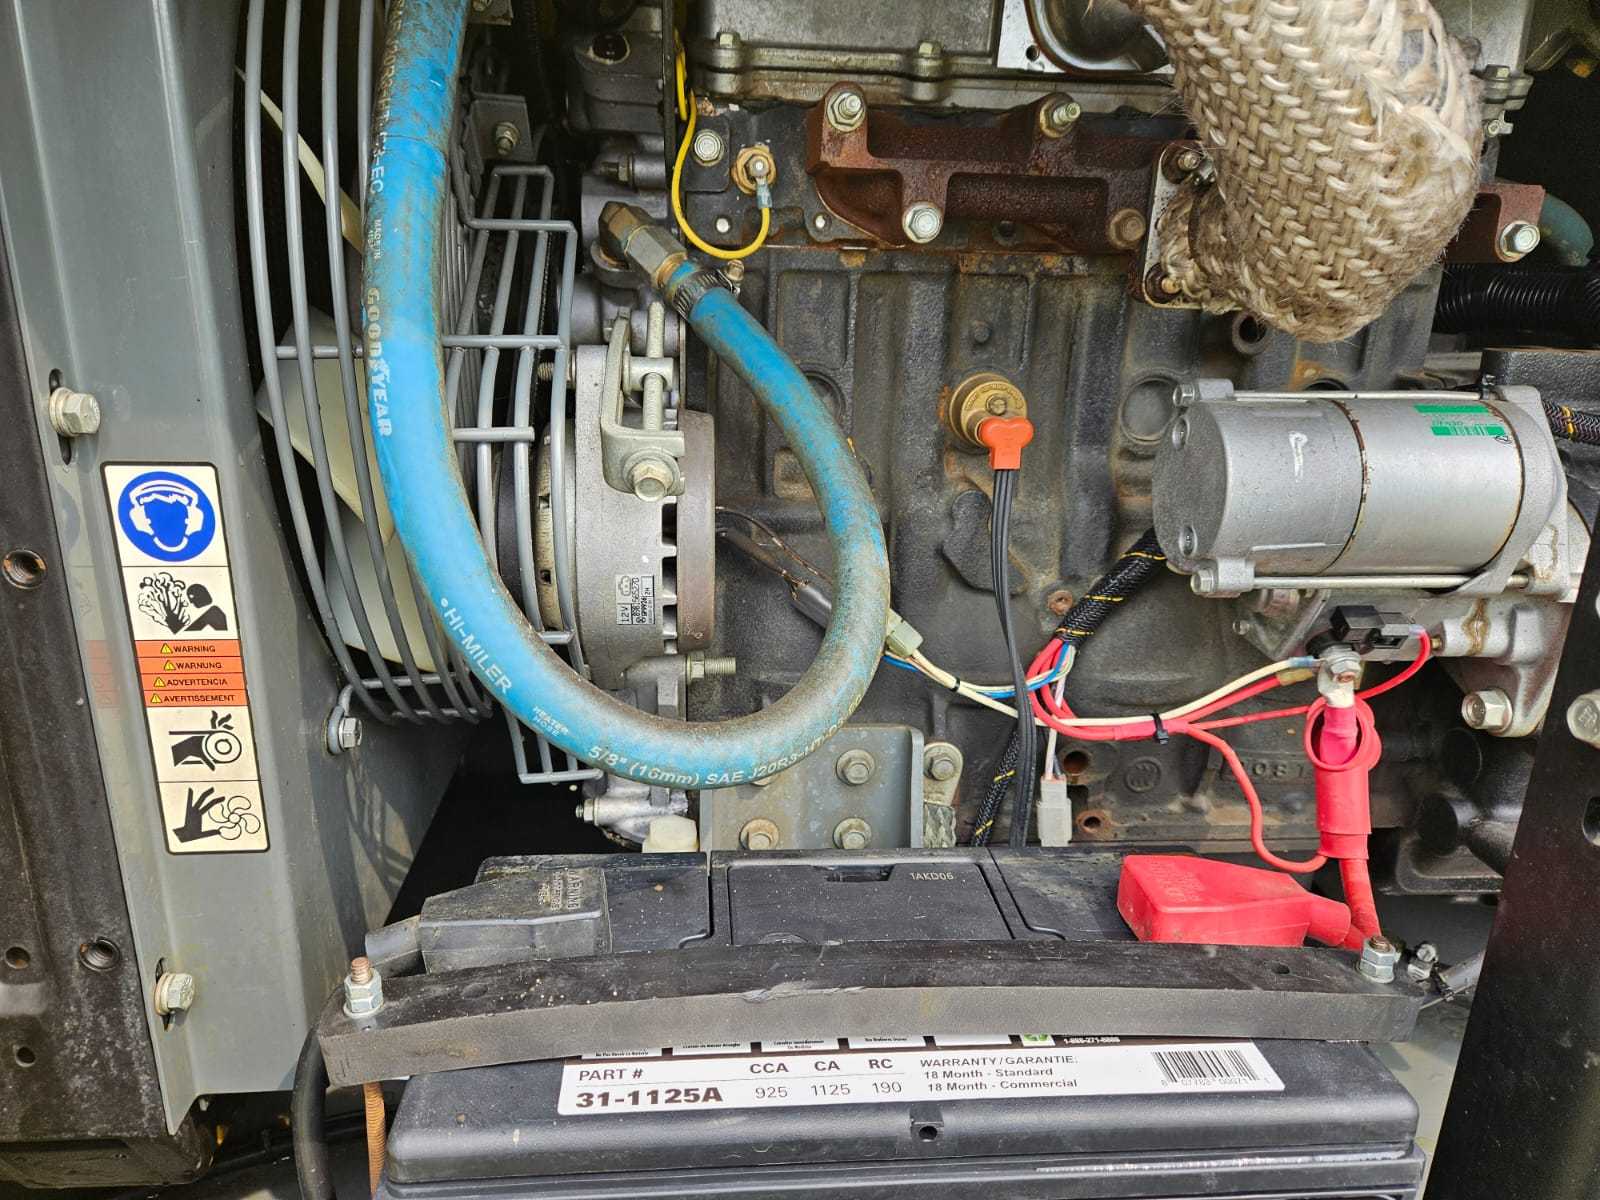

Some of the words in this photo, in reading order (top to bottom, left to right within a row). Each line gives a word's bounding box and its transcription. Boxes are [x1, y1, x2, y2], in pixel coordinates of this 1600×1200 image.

[367, 287, 392, 437] GOODYEAR
[173, 645, 216, 653] WARNING
[443, 607, 513, 694] HI-MILER
[176, 661, 222, 669] WARNUNG
[167, 678, 229, 687] ADVERTENCIA
[163, 694, 236, 703] AVERTISSEMENT
[705, 772, 745, 787] SAE
[579, 1068, 627, 1081] PART
[632, 1067, 644, 1079] #
[750, 1062, 790, 1075] CCA
[814, 1060, 841, 1072] CA
[868, 1058, 894, 1070] RC
[924, 1070, 939, 1080] 18
[942, 1069, 984, 1080] Month
[995, 1067, 1054, 1079] Standard
[927, 1082, 943, 1093] 18
[946, 1081, 988, 1092] Month
[999, 1079, 1078, 1090] Commercial
[575, 1086, 724, 1109] 31-1125A
[754, 1086, 789, 1099] 925
[810, 1083, 851, 1097] 1125
[872, 1081, 903, 1095] 190
